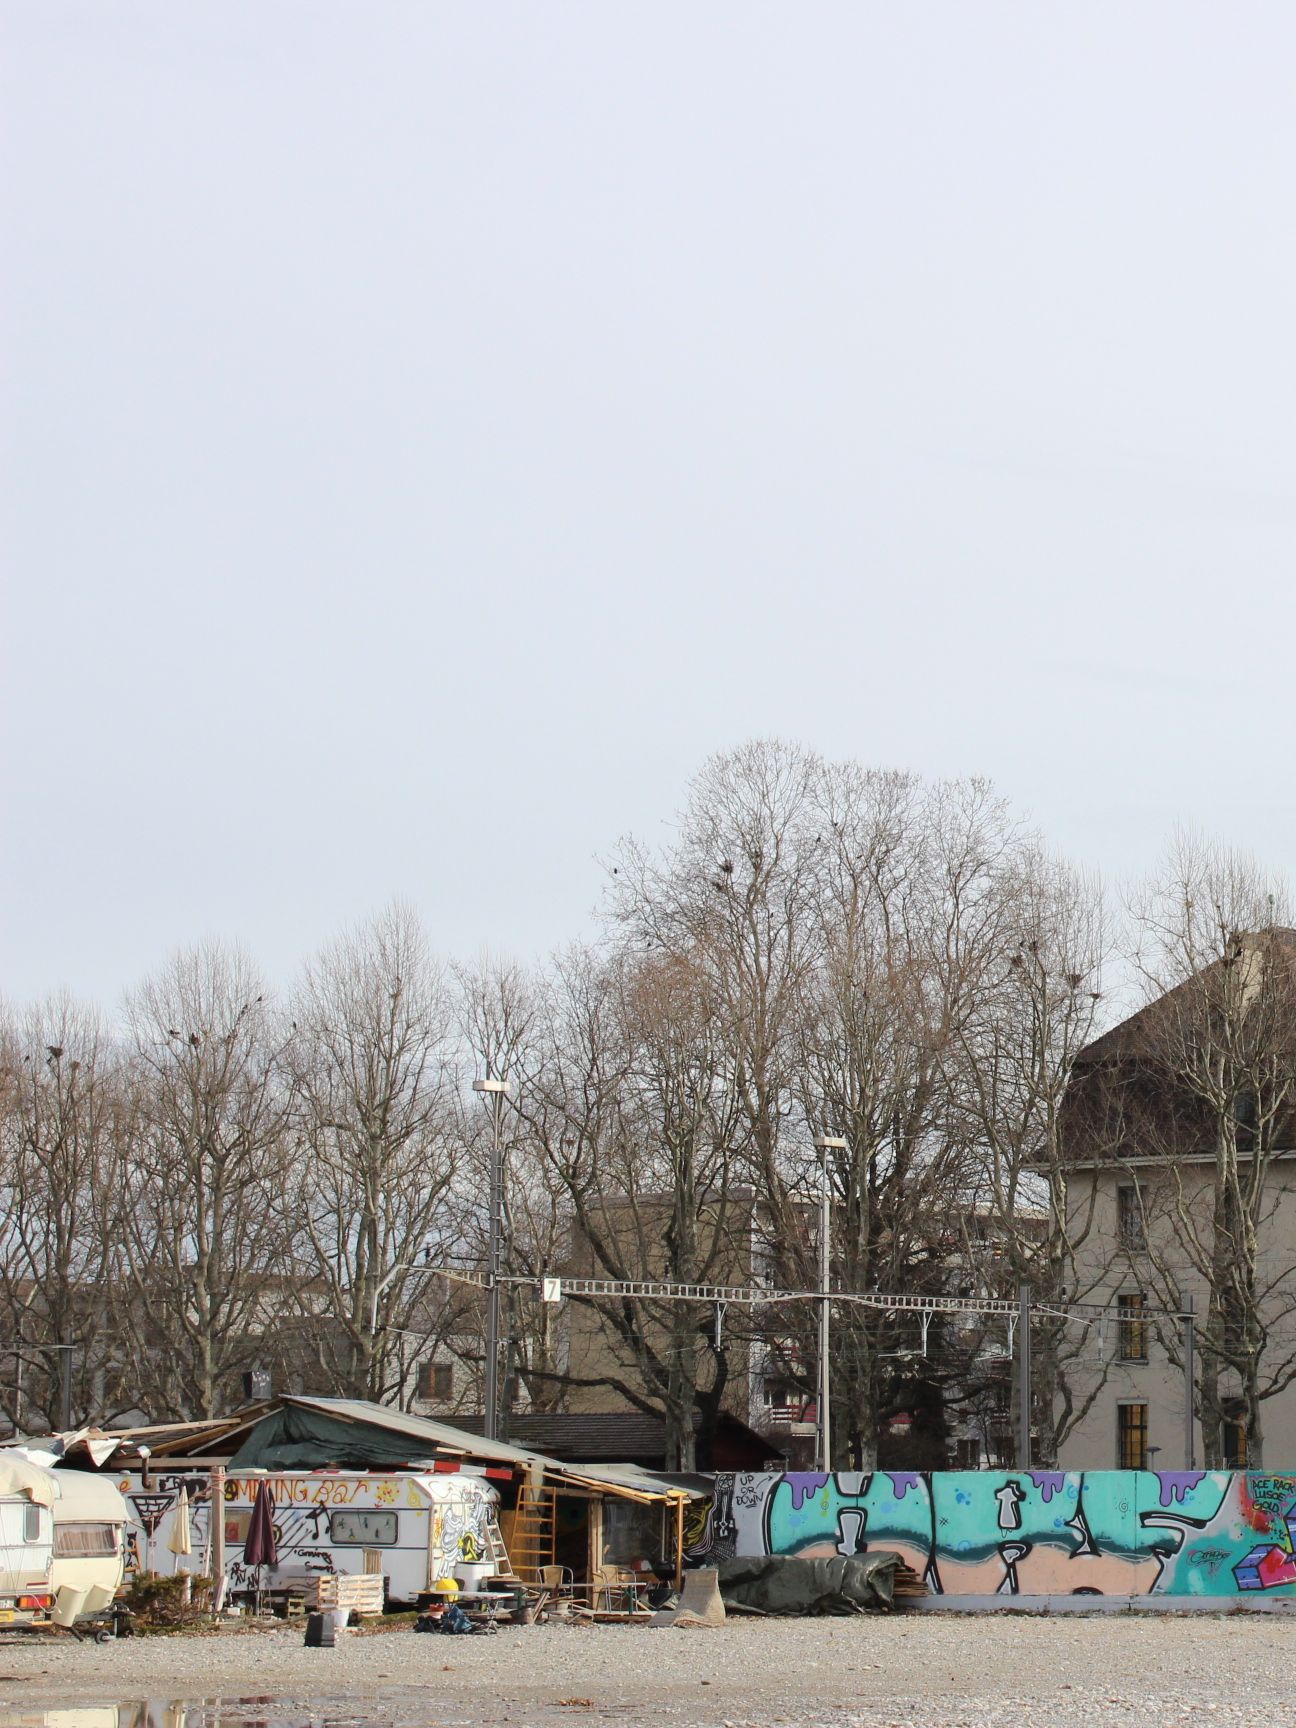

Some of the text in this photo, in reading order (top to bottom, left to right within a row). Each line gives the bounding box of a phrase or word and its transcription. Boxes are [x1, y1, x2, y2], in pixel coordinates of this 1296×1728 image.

[547, 1280, 557, 1300] 7
[740, 1474, 754, 1486] UP
[736, 1491, 764, 1506] DOWN
